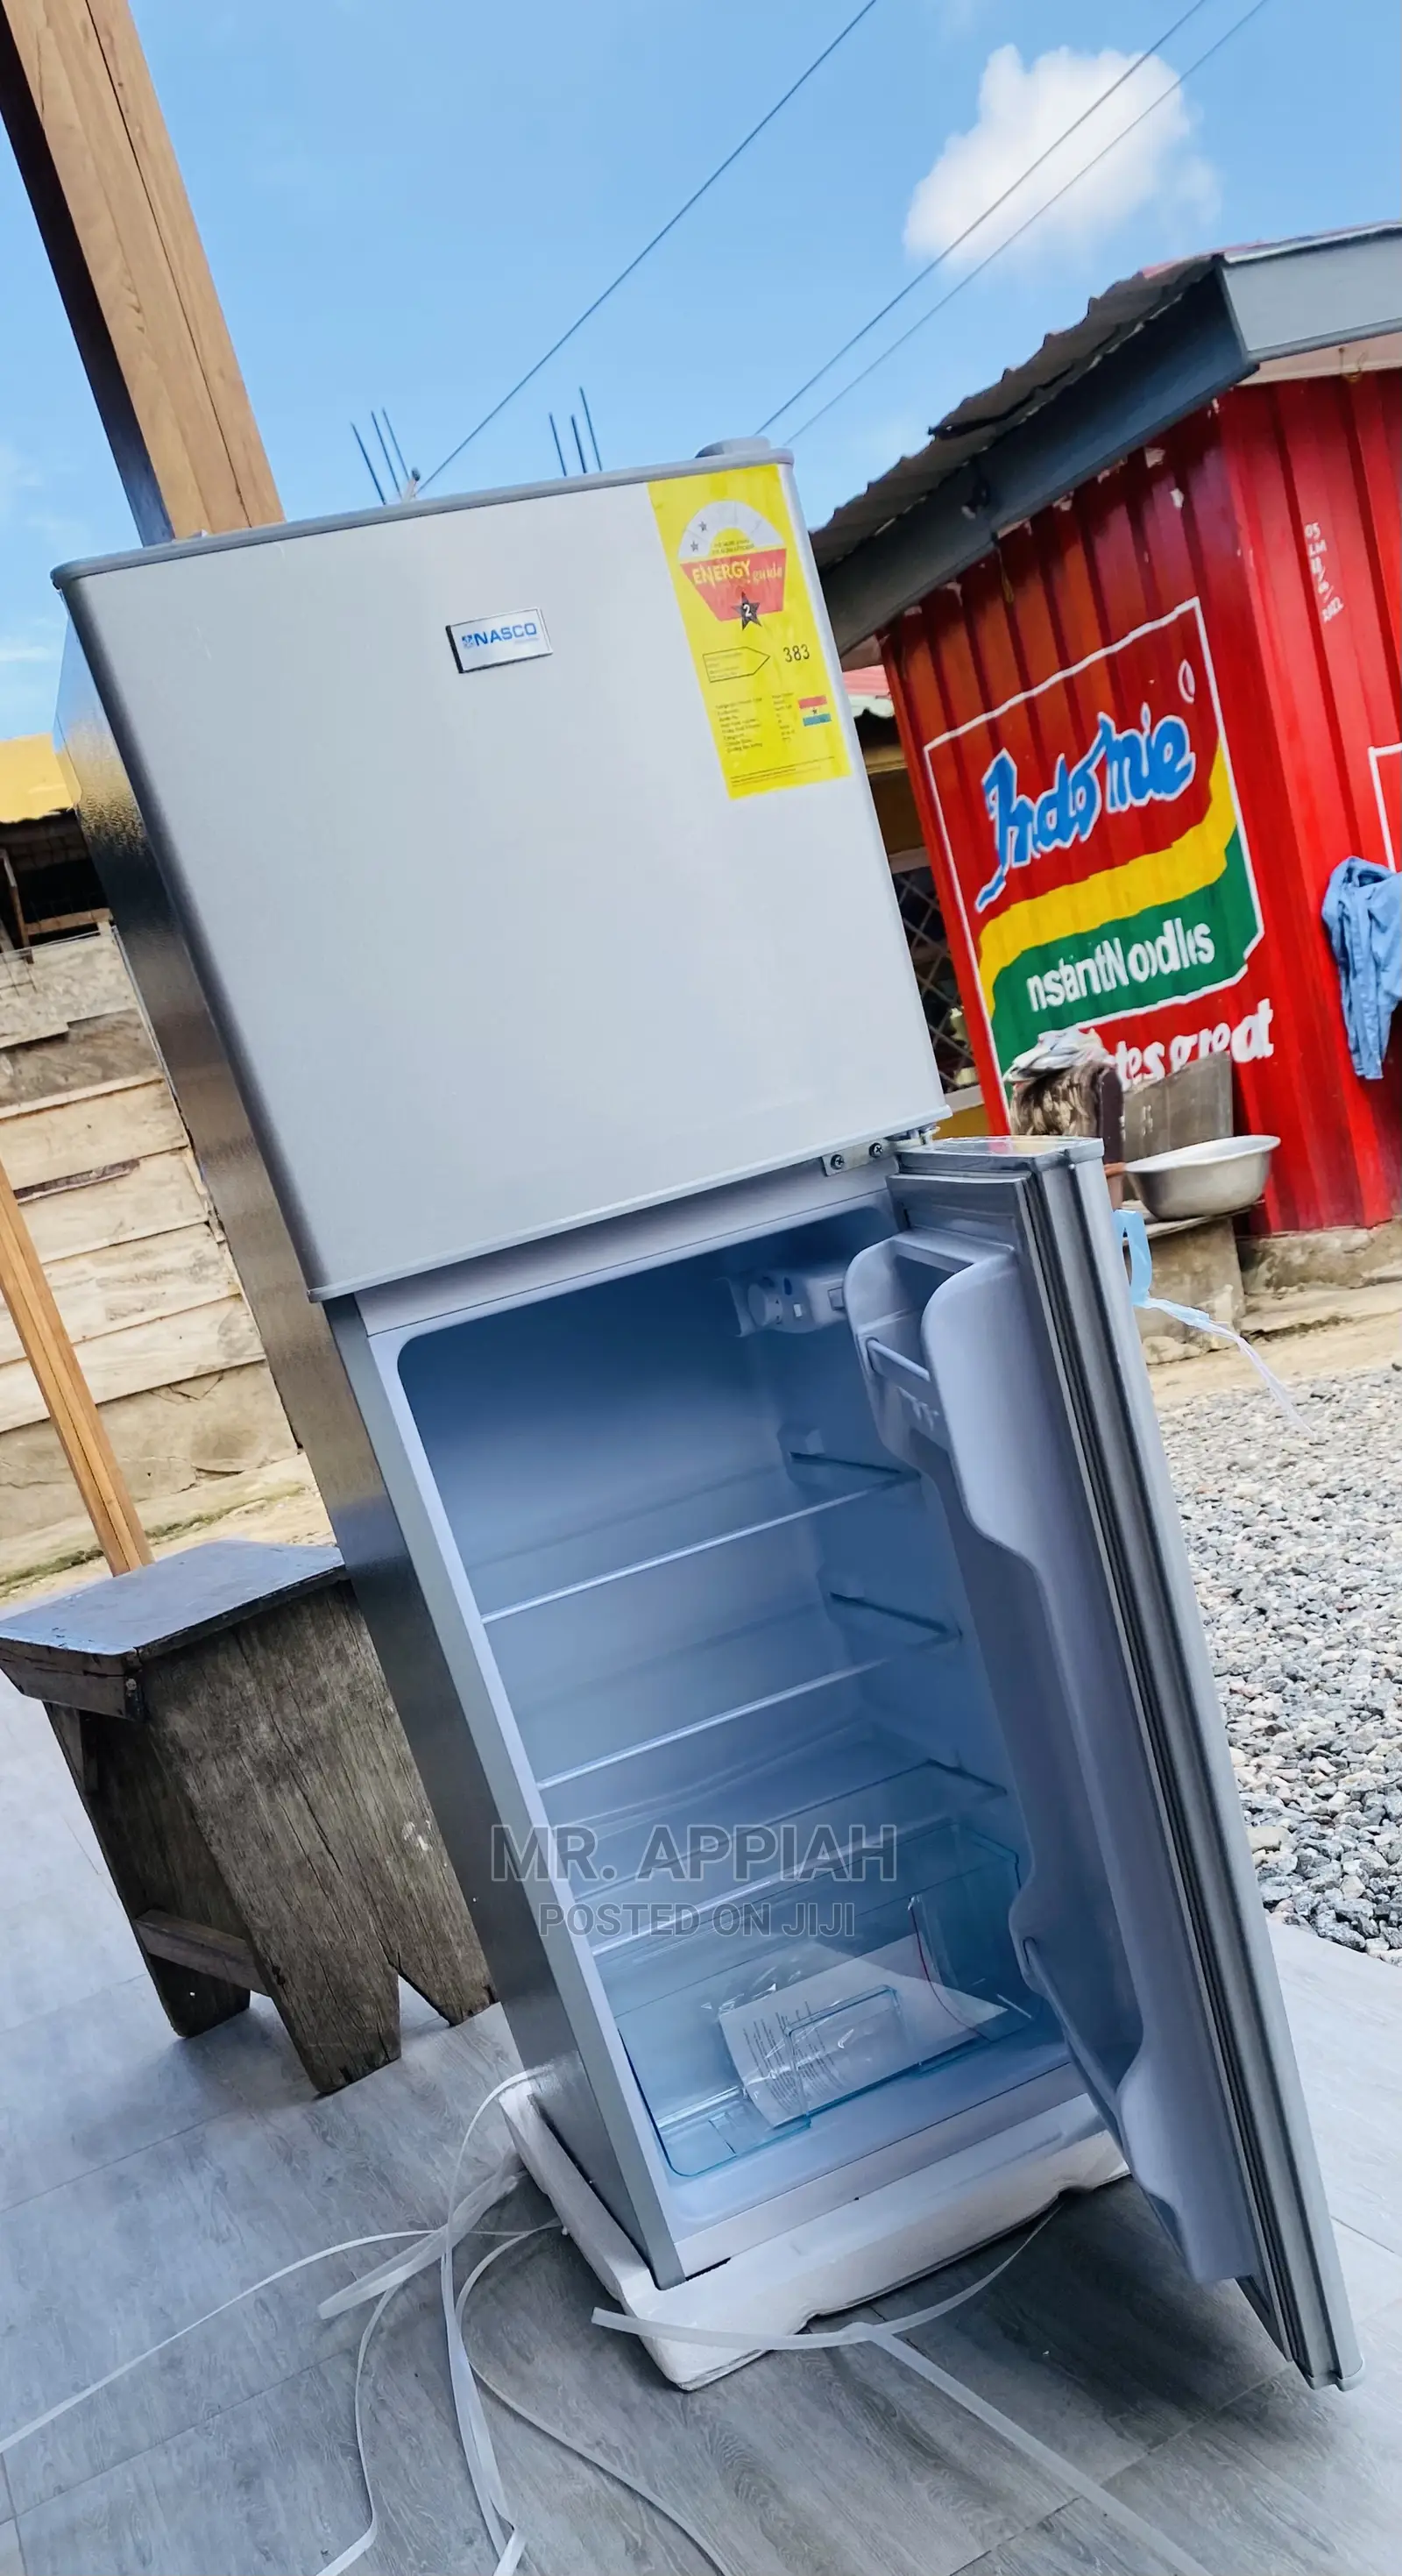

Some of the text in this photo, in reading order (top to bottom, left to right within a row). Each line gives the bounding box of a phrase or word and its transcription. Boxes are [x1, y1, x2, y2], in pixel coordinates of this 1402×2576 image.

[691, 560, 752, 588] ENERGY
[742, 604, 752, 617] 2
[473, 622, 537, 646] NASCO
[782, 643, 811, 664] 383
[974, 701, 1196, 913] Indomie
